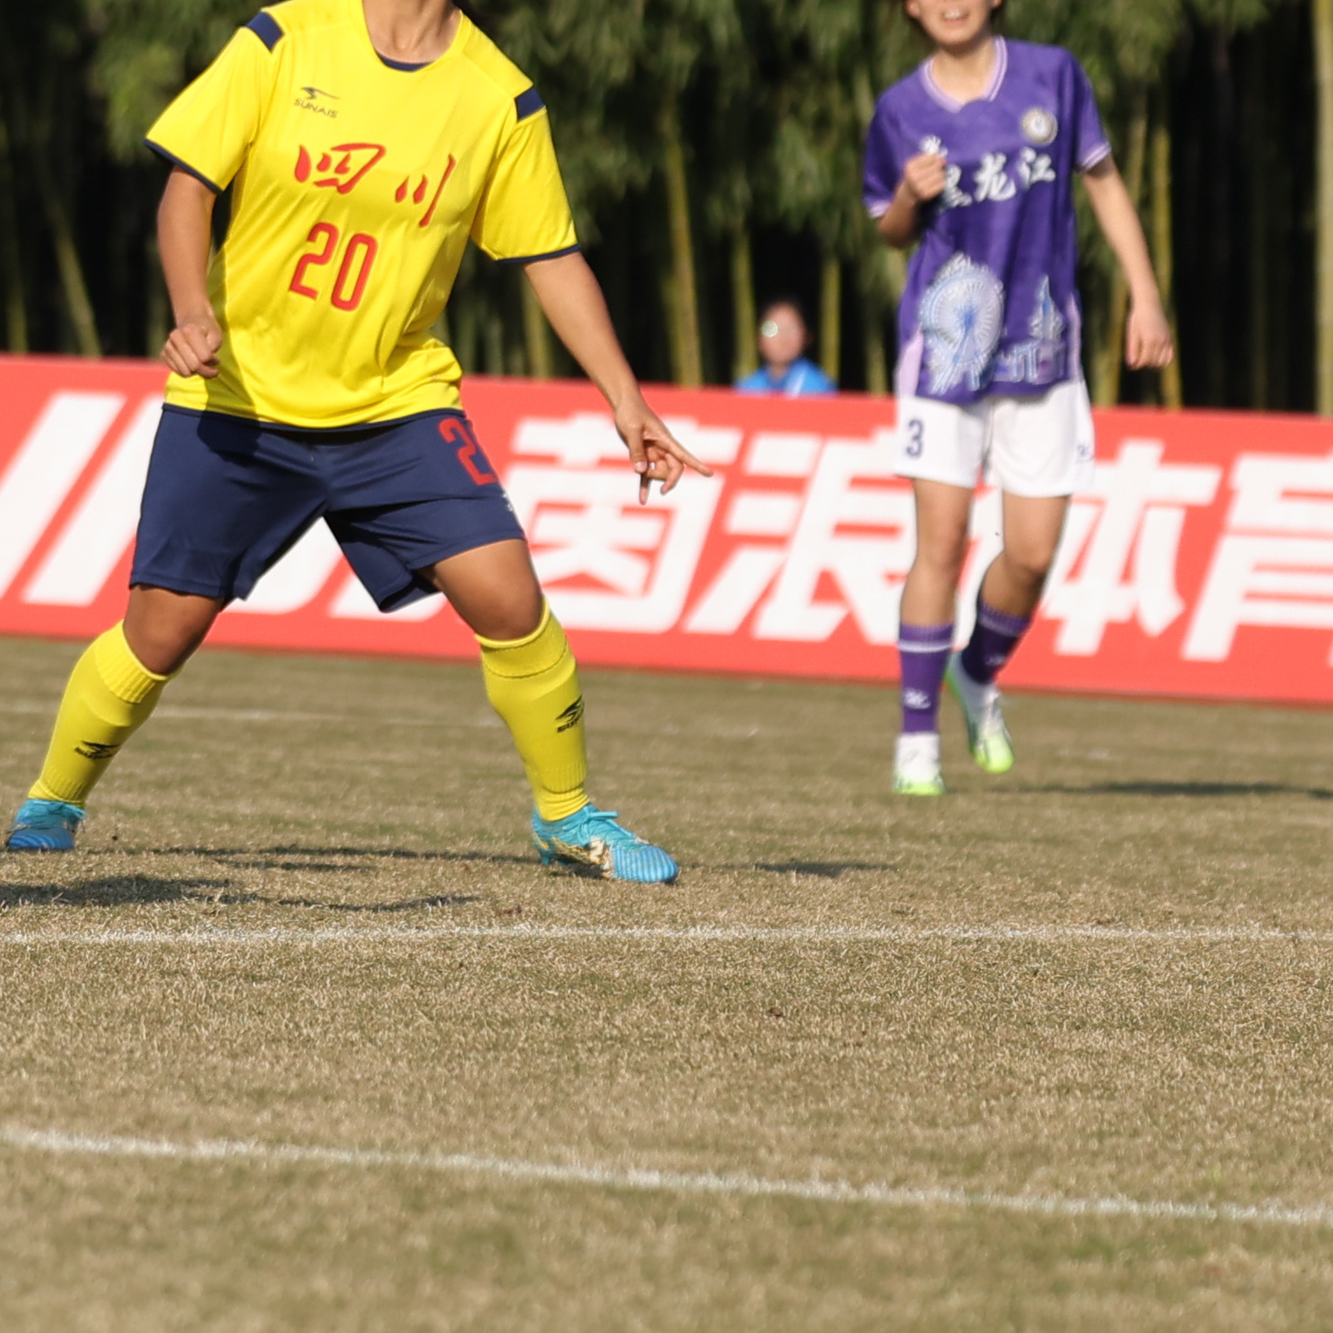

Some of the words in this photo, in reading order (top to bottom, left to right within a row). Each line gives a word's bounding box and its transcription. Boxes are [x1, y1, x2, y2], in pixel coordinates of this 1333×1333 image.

[294, 98, 338, 118] SUNAIS
[294, 142, 457, 228] 四川
[289, 222, 378, 312] 20
[438, 417, 497, 486] 2
[906, 418, 925, 457] 3
